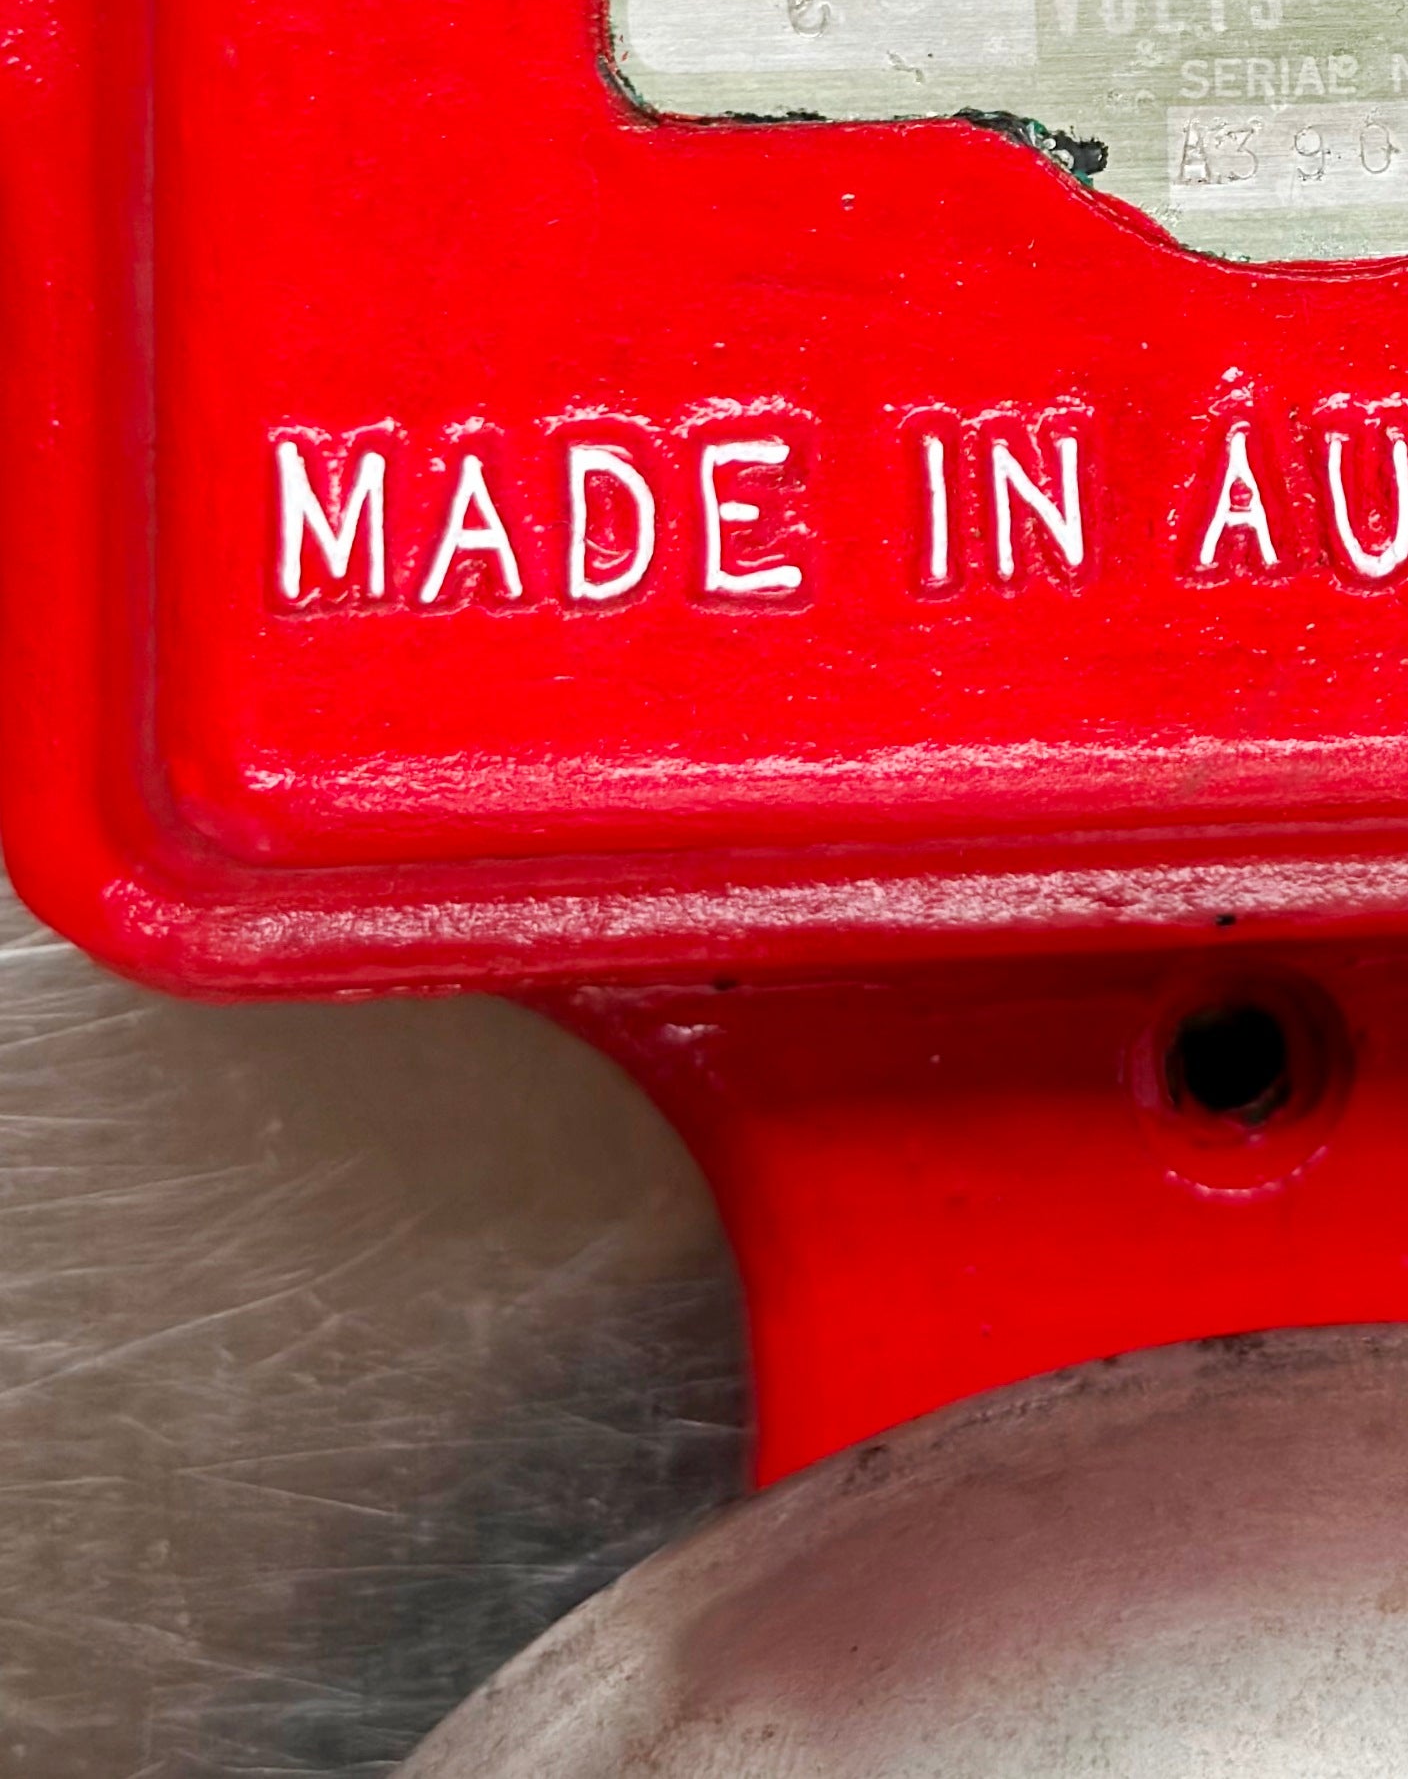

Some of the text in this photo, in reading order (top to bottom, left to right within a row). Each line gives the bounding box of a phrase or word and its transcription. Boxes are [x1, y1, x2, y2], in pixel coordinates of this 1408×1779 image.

[1178, 54, 1359, 101] SERIAL
[276, 439, 803, 604] MADE
[923, 434, 1087, 581] IN
